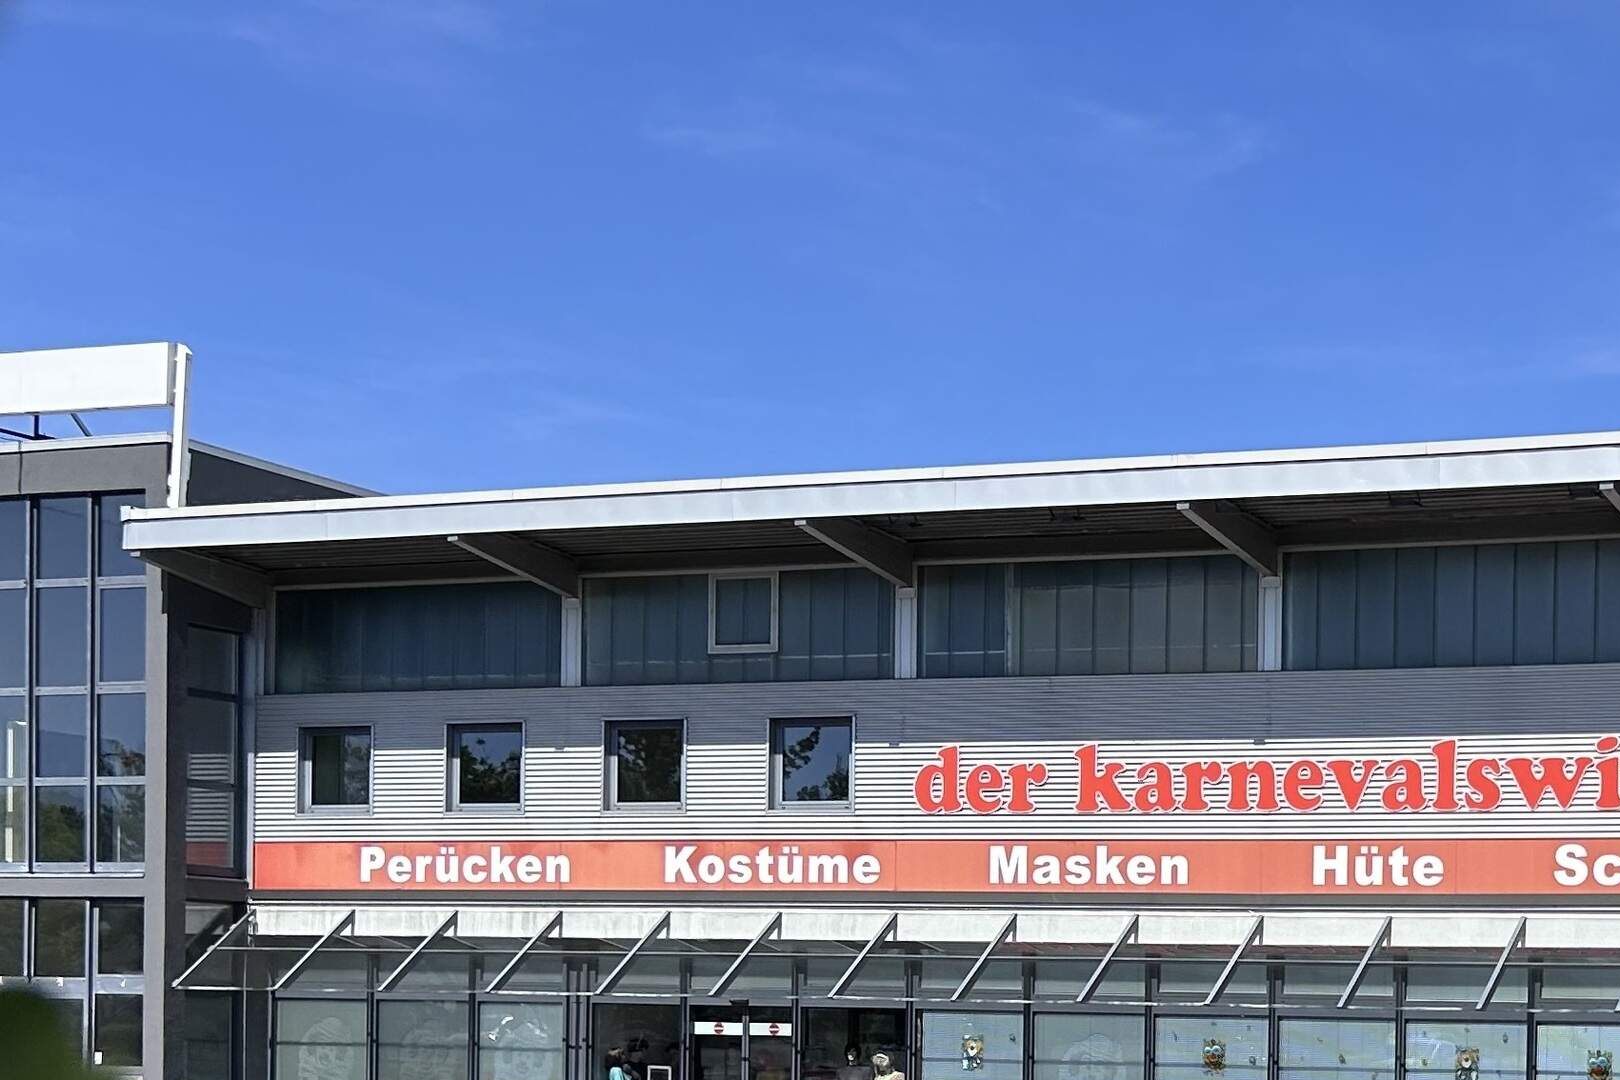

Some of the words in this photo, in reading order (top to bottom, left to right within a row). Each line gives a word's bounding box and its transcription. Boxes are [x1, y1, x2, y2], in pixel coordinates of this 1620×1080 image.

[914, 746, 1047, 814] der
[359, 846, 571, 884] Perücken
[664, 846, 881, 884] Kostüme
[988, 845, 1189, 886] Masken
[1312, 844, 1444, 886] Hüte
